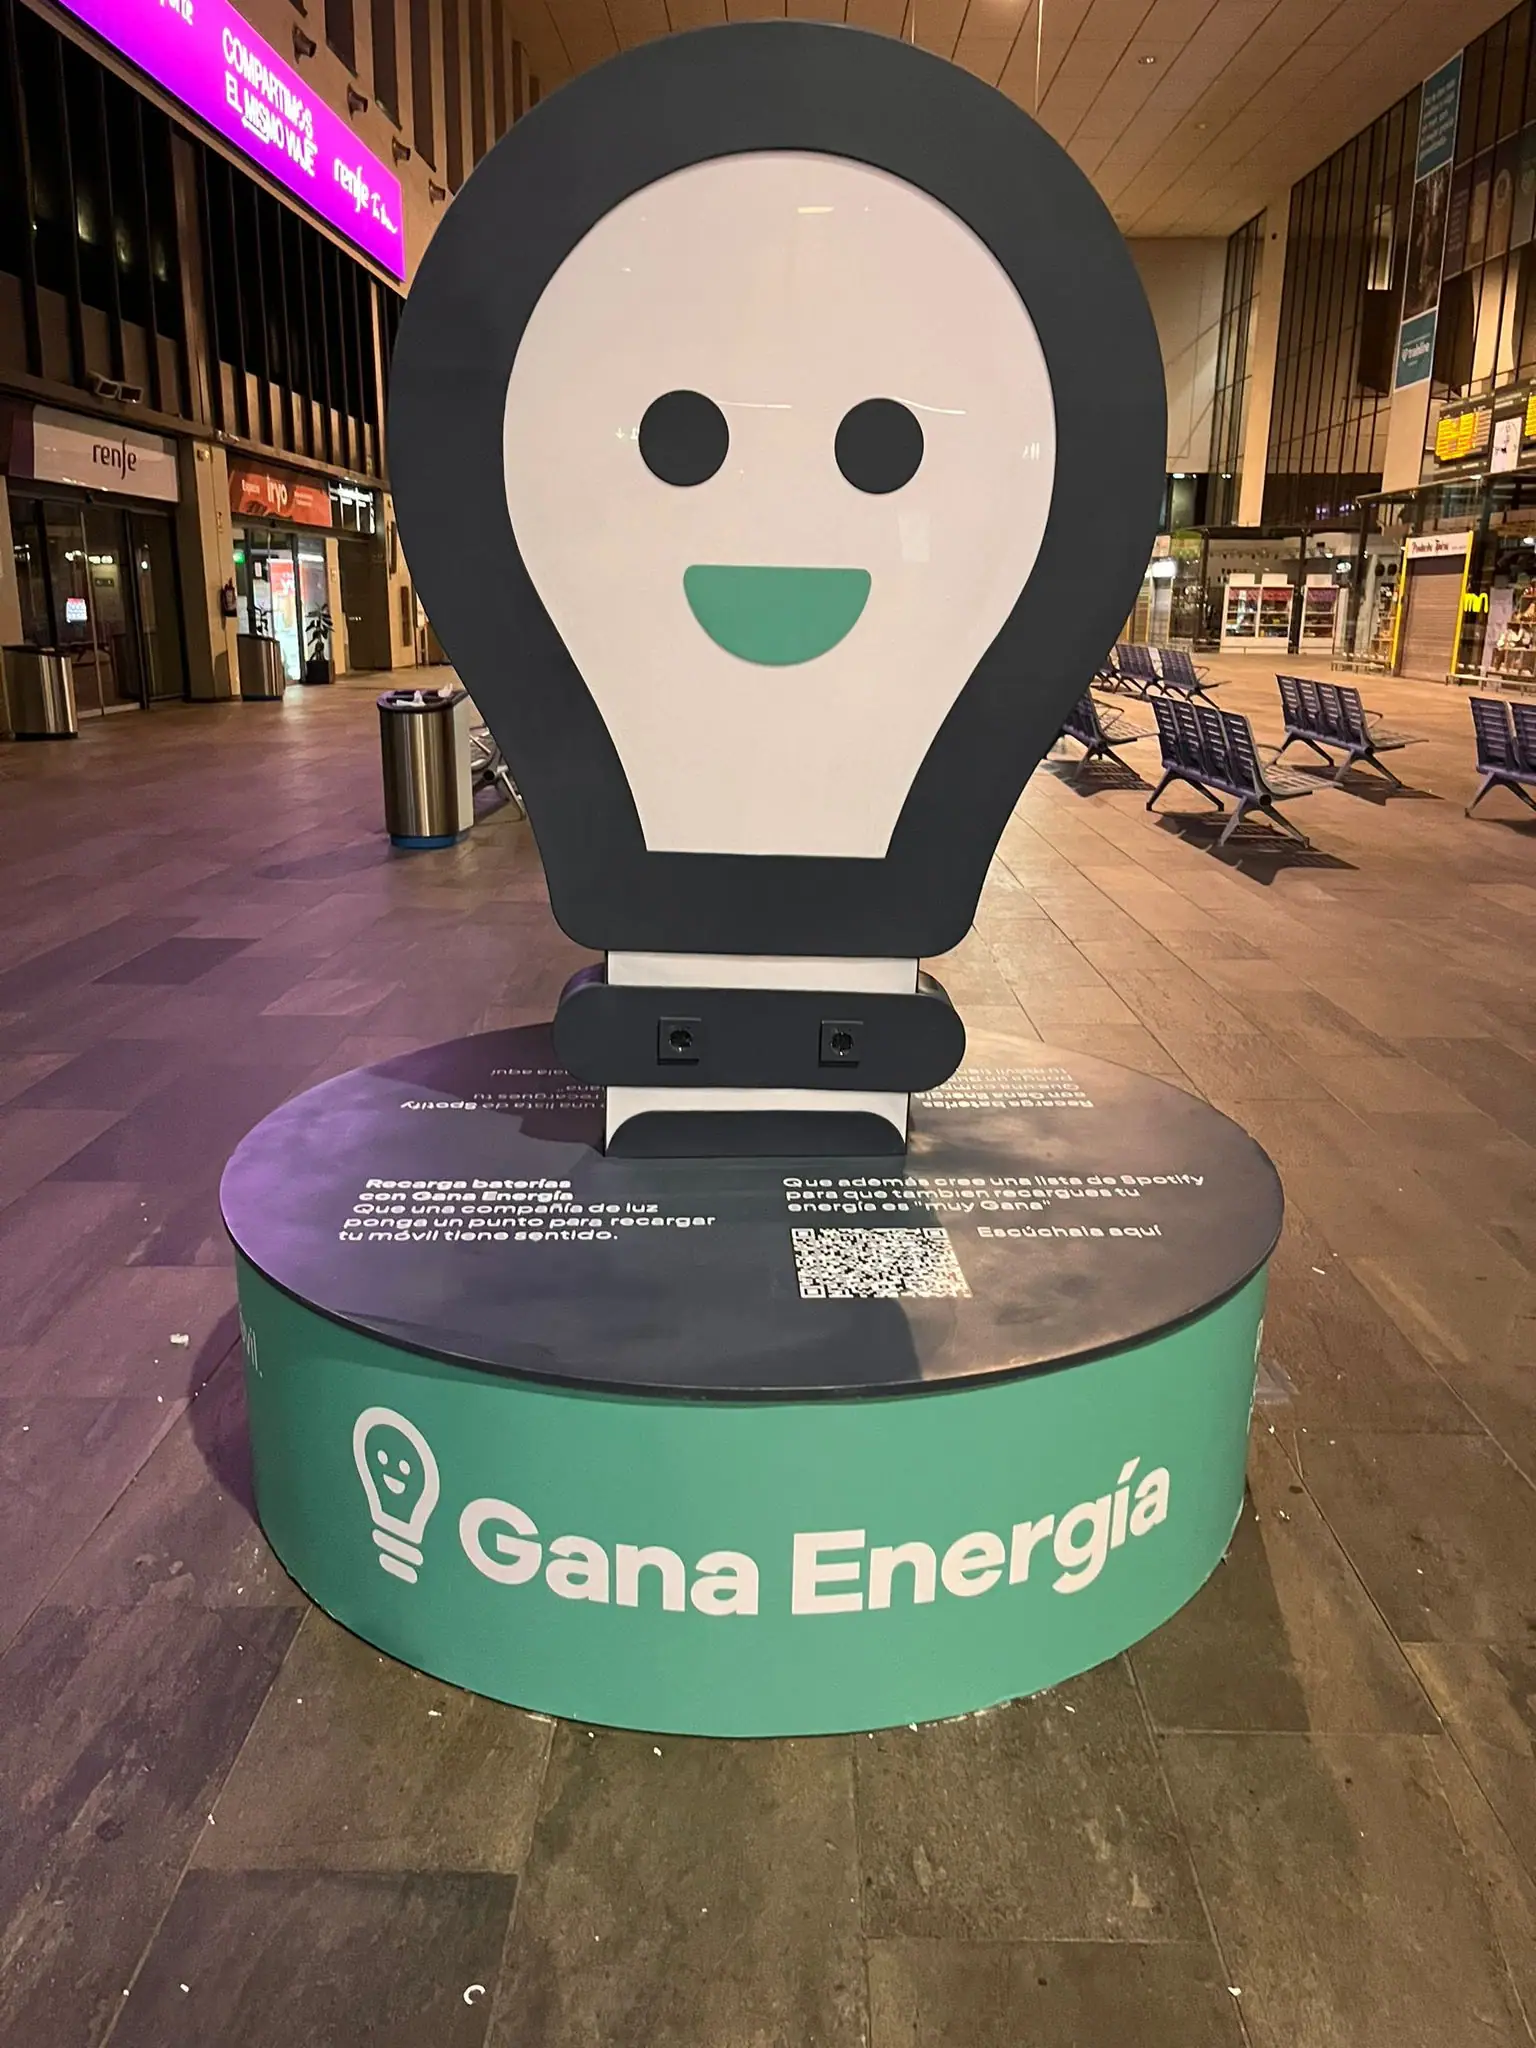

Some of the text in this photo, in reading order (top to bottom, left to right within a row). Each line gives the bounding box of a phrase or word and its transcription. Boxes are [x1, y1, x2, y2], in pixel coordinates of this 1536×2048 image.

[222, 27, 315, 140] COMPARTIMOS
[225, 70, 319, 178] EL MISMO VIAJE
[333, 157, 370, 213] renfe
[92, 438, 137, 481] renfe
[266, 473, 288, 512] iryo
[473, 1092, 600, 1101] recargues tu
[914, 1091, 990, 1101] Energía
[991, 1091, 1045, 1100] Gana
[400, 1100, 478, 1110] Spotify
[482, 1102, 508, 1110] de
[560, 1101, 596, 1109] una
[922, 1100, 1095, 1110] Recarga baterías
[365, 1179, 572, 1190] Recarga baterías
[782, 1174, 1205, 1188] Que además cree una lista de Spotify
[359, 1191, 574, 1203] con Gana Energía
[786, 1190, 838, 1201] para
[843, 1189, 888, 1201] que
[993, 1188, 1113, 1200] recargues
[1114, 1187, 1141, 1198] tu
[353, 1202, 659, 1215] Que una compañía de luz
[787, 1199, 1051, 1214] energía es "muy Gana"
[343, 1216, 717, 1229] ponga un punto para recargar
[338, 1229, 619, 1242] tu móvil tiene sentido.
[977, 1224, 1162, 1239] Escúchala aquí
[458, 1456, 1171, 1617] Gana Energía
